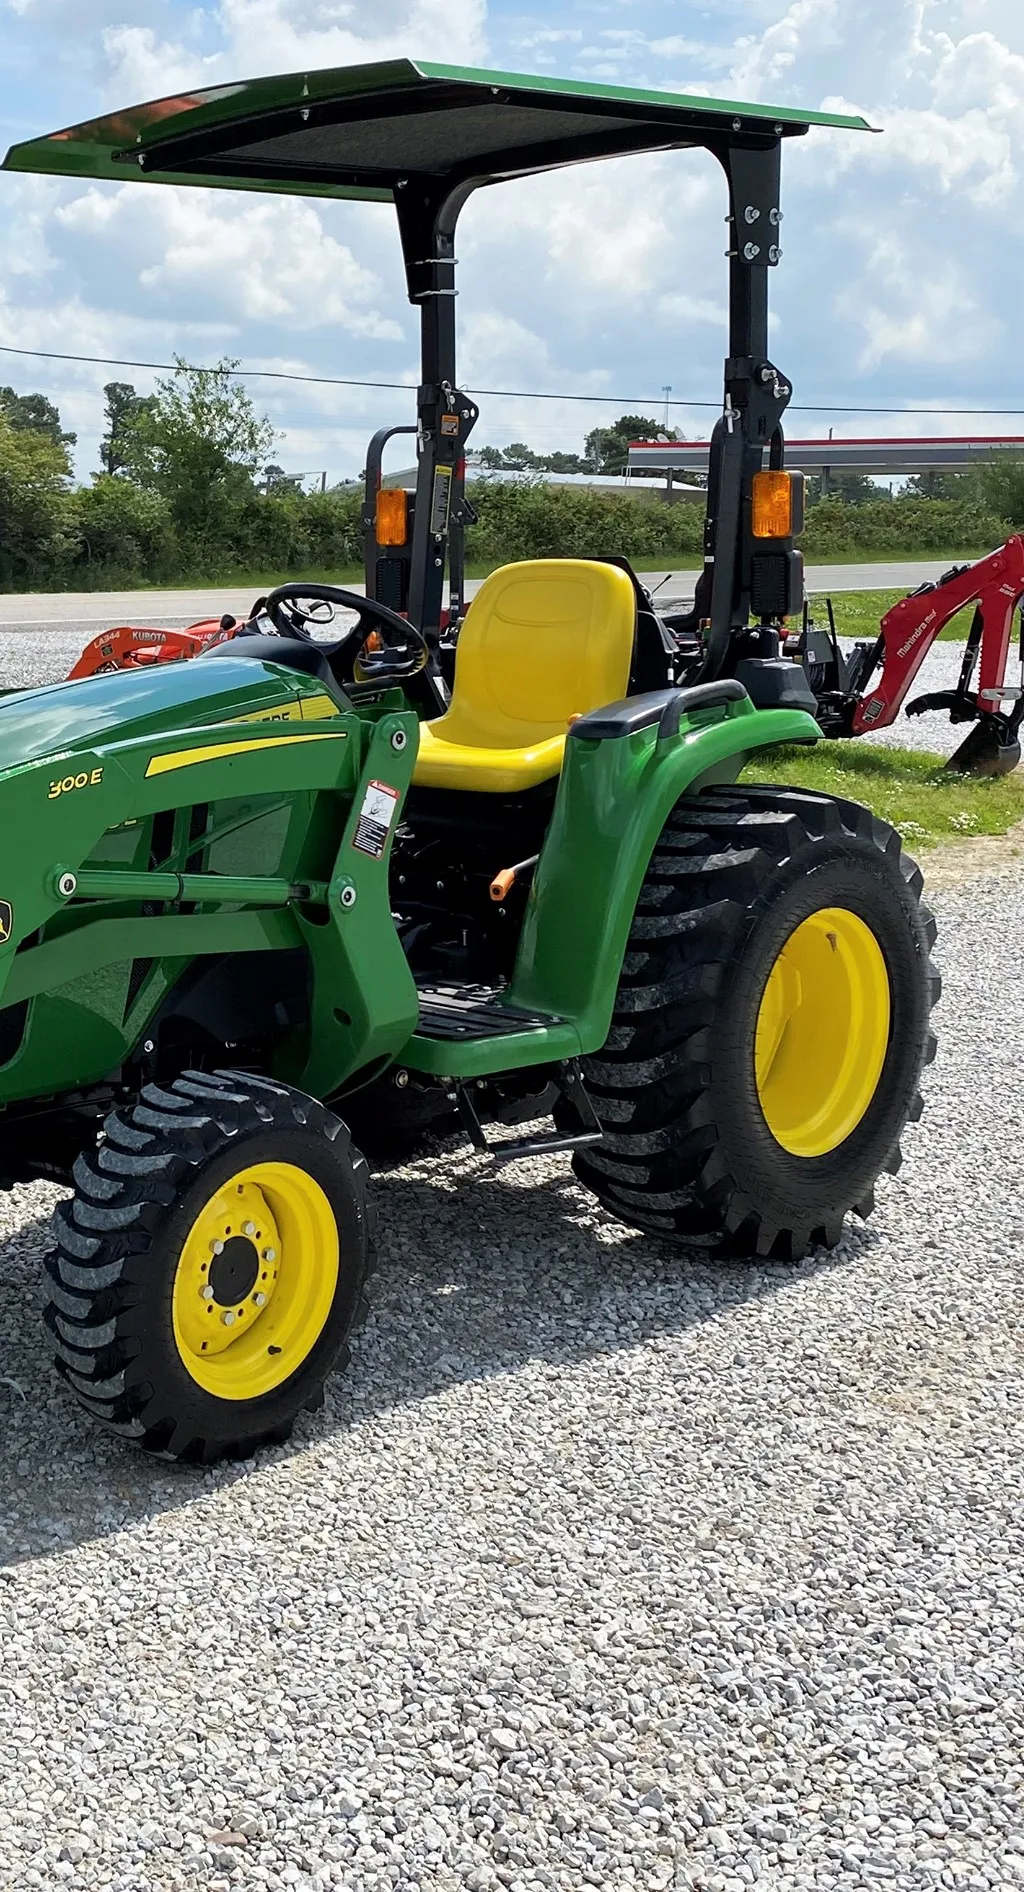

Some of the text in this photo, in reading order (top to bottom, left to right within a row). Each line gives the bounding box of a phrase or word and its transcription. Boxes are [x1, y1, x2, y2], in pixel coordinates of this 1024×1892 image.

[93, 630, 121, 649] LA344
[132, 631, 166, 643] KUBOTA
[896, 622, 928, 659] Mahindra
